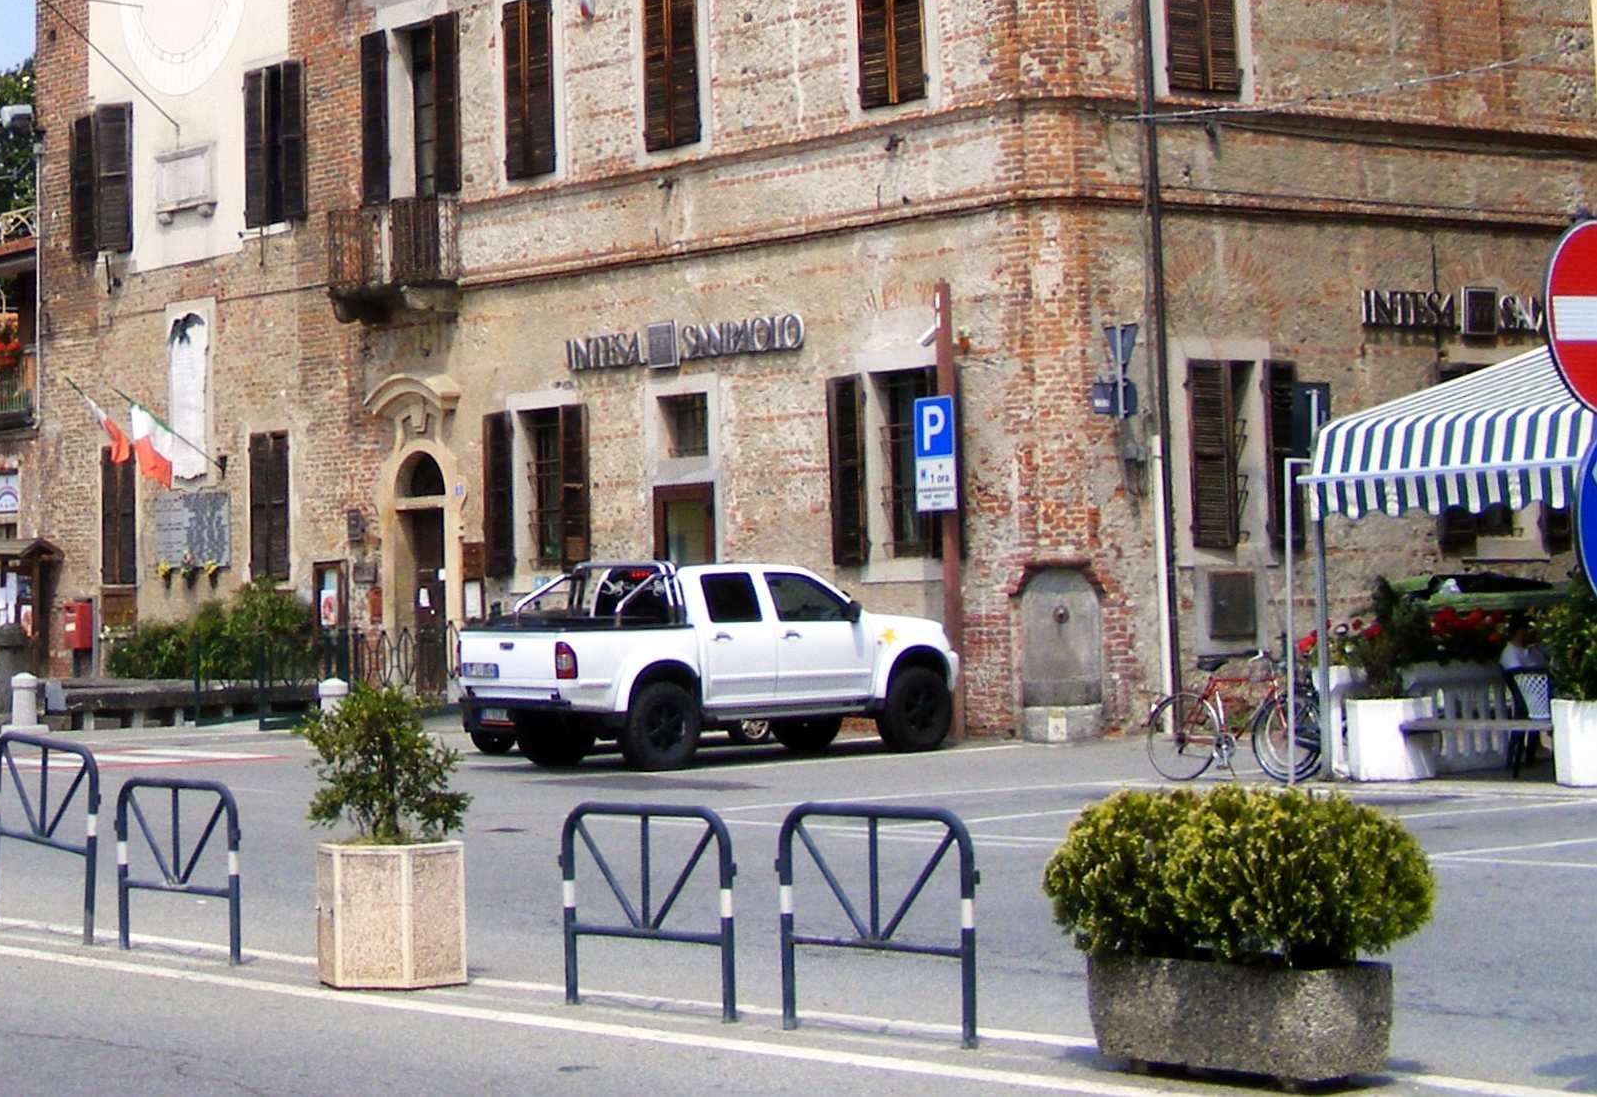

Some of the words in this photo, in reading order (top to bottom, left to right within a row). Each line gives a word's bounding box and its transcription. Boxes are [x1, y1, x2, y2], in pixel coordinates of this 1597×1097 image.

[1361, 289, 1454, 327] INTESA
[566, 331, 648, 370] INTESA
[681, 313, 805, 360] SANPAOLO
[922, 405, 946, 451] P
